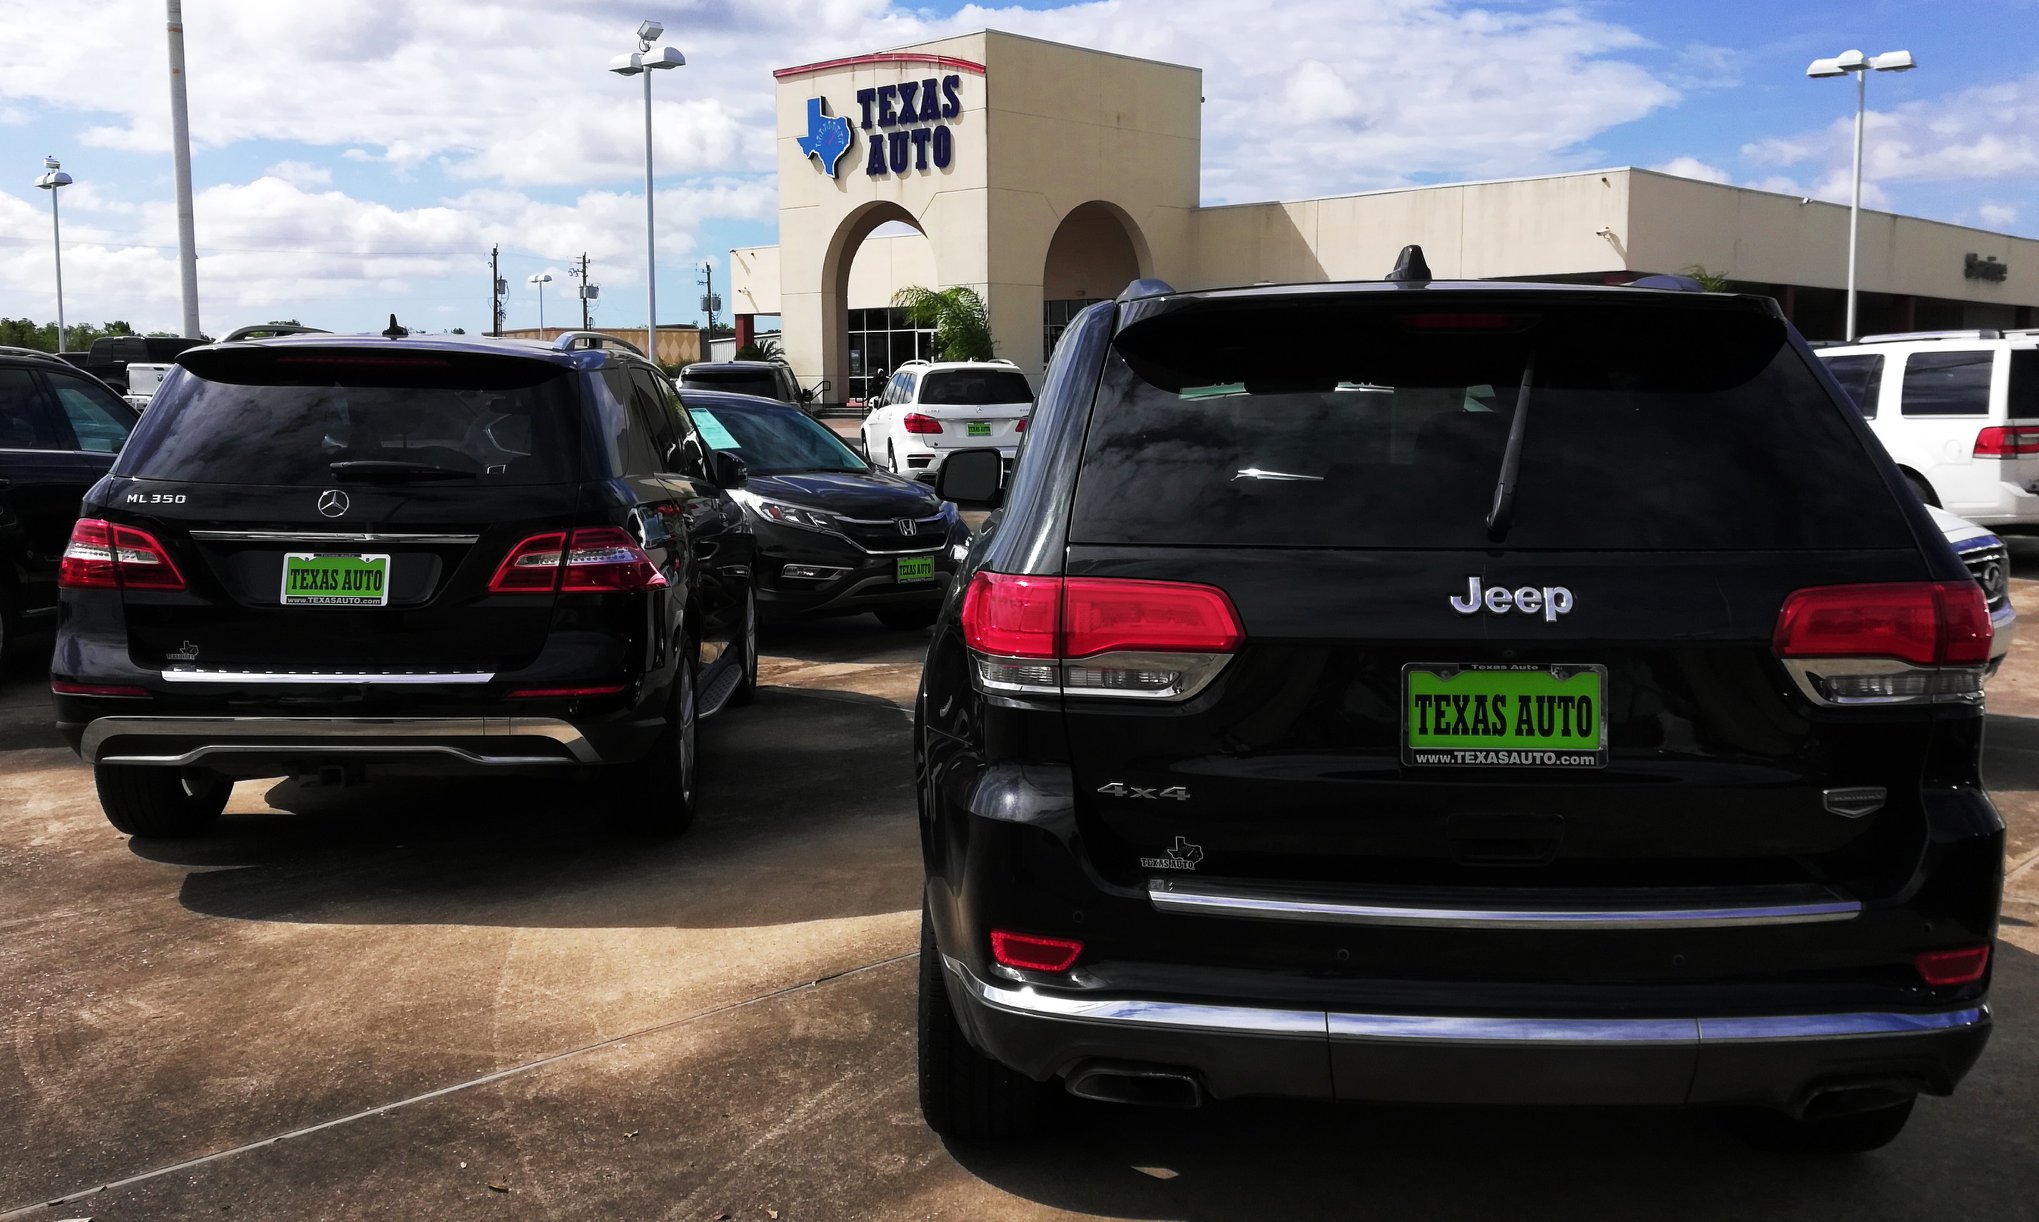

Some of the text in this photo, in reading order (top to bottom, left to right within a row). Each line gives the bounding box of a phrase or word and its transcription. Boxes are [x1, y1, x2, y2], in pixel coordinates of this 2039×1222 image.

[857, 75, 960, 130] TEXAS
[866, 125, 951, 175] AUTO
[126, 494, 187, 504] ML 350
[899, 563, 931, 576] TEXAS AUTO
[290, 568, 383, 591] TEXAS AUTO
[287, 597, 381, 605] www.TEXASAUTO.com
[1450, 577, 1573, 622] Jeep
[1415, 694, 1593, 738] TEXAS AUTO
[1416, 751, 1595, 766] www.TEXASAUTO.com
[1097, 782, 1191, 801] 4x4
[1140, 858, 1194, 870] TEXAS AUTO
